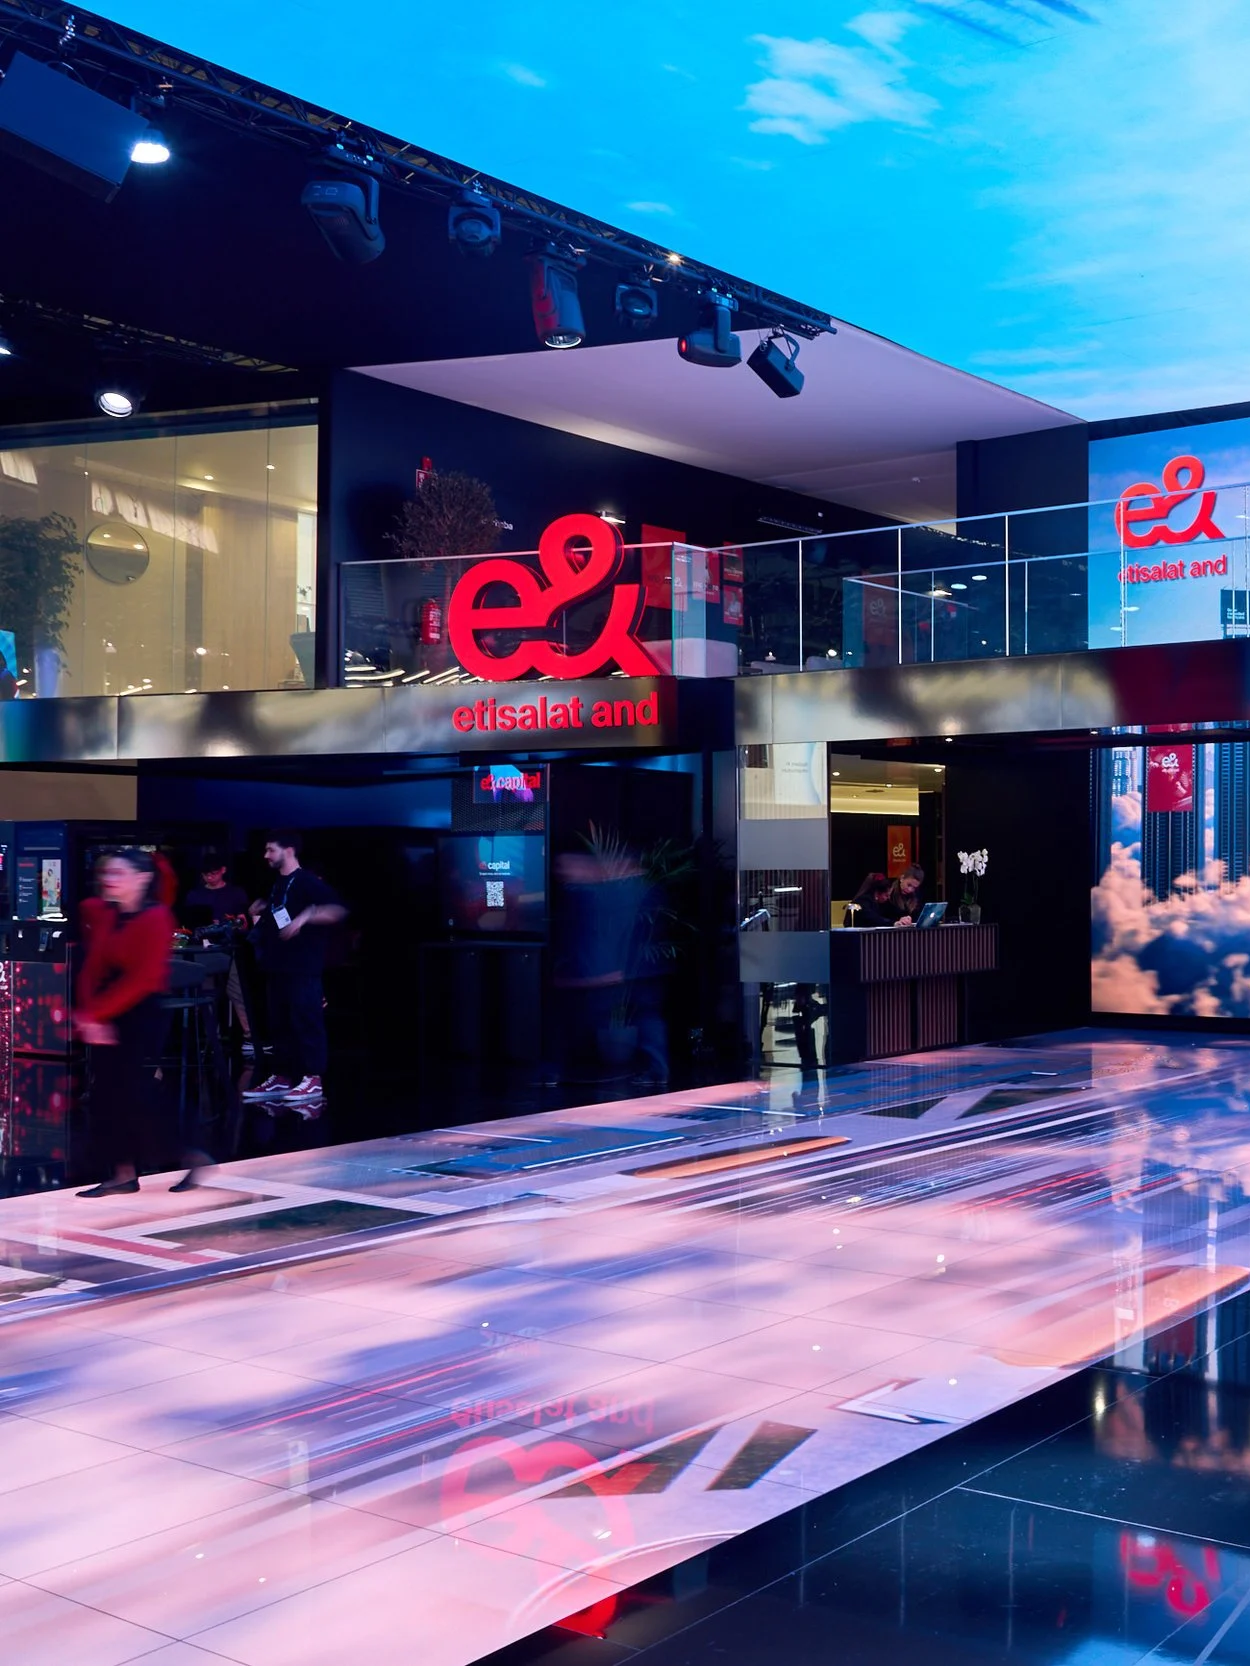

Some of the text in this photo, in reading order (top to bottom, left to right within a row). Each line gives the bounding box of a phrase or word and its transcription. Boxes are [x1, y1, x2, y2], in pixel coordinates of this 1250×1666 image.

[1114, 455, 1226, 548] e&
[1189, 554, 1228, 578] and
[448, 513, 664, 681] e&
[452, 692, 659, 732] etisalat and
[487, 861, 510, 871] capital
